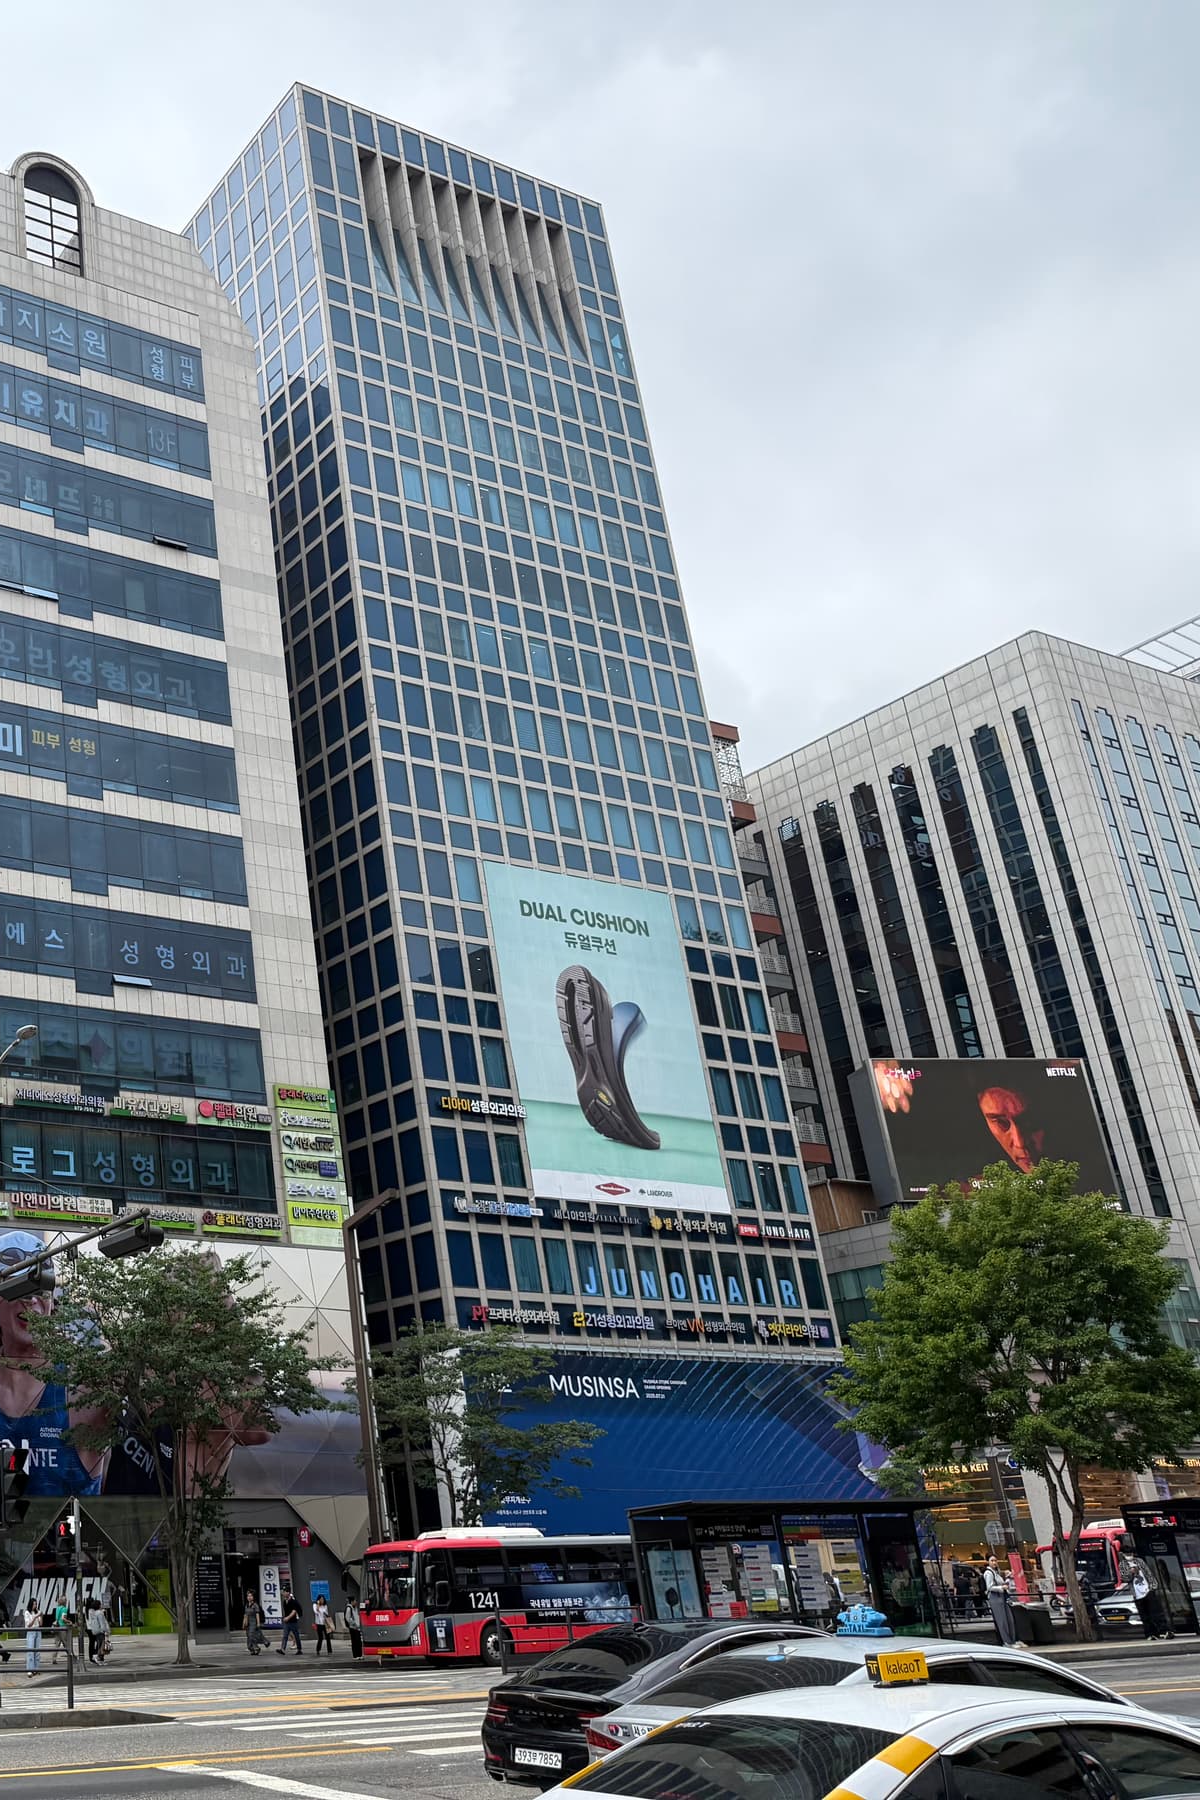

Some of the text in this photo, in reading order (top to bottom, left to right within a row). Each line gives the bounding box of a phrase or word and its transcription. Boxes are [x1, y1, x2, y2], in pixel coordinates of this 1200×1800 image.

[32, 728, 60, 749] 피부
[69, 736, 96, 756] 성형
[519, 899, 649, 937] DUAL CUSHION
[564, 931, 617, 956] 듀얼쿠션
[120, 940, 246, 979] 성형외과
[1046, 1067, 1077, 1077] NETFLIX
[11, 1192, 77, 1212] 미앤미의원
[761, 1226, 811, 1239] JUNO HAIR
[549, 1375, 640, 1399] MUSINSA
[264, 1583, 277, 1598] 약
[469, 1592, 500, 1609] 1241
[850, 1623, 864, 1633] TAXI
[539, 1752, 559, 1767] 7852
